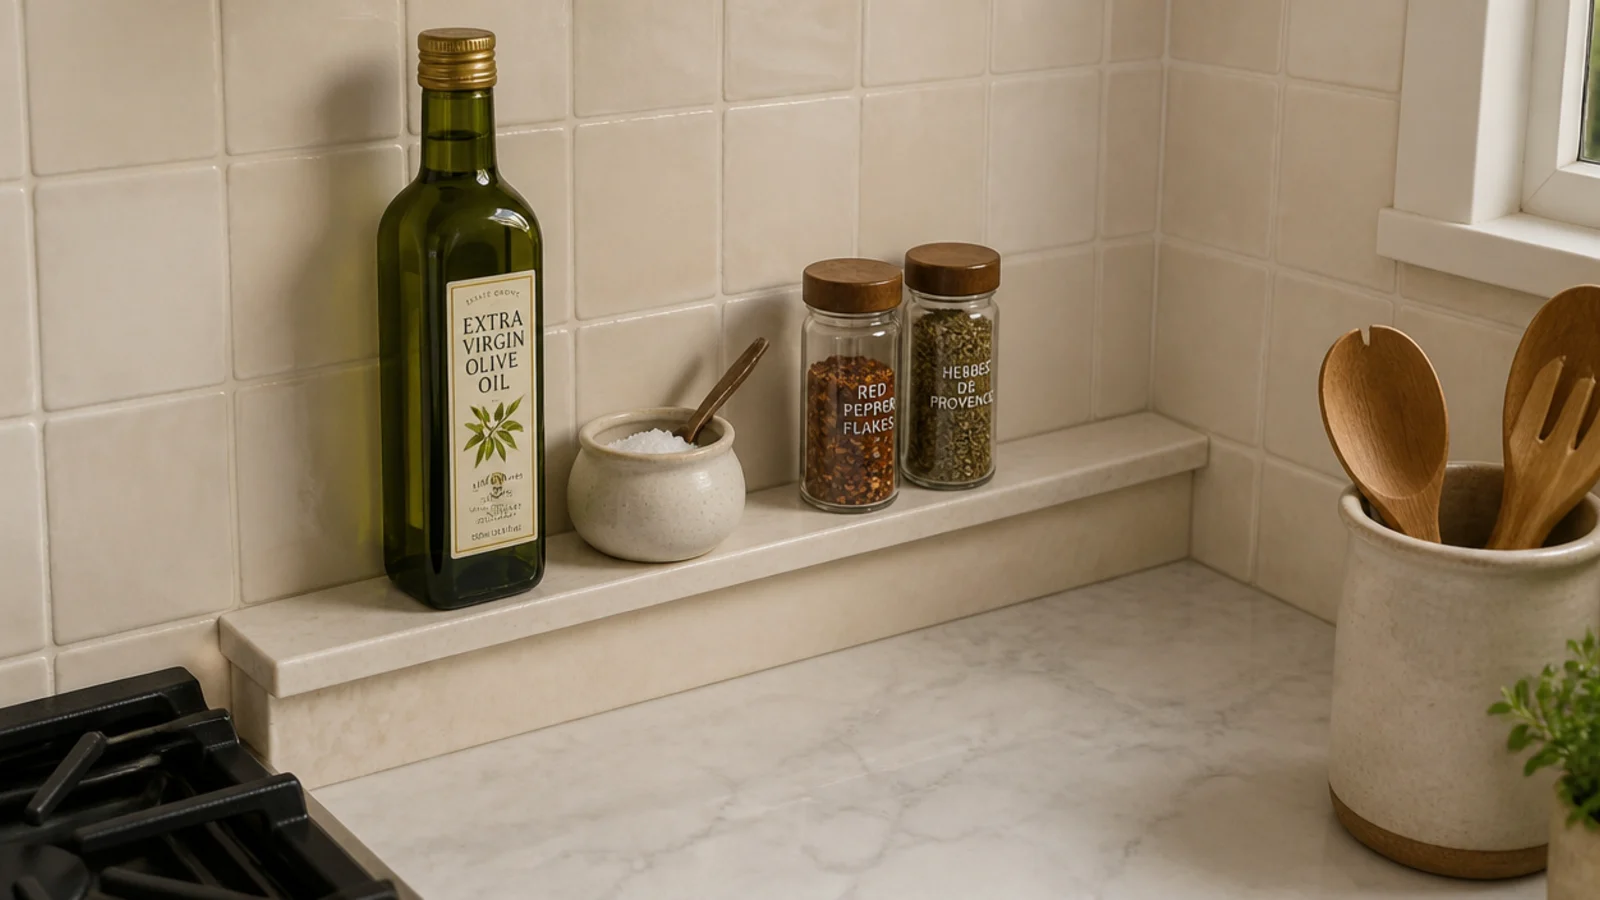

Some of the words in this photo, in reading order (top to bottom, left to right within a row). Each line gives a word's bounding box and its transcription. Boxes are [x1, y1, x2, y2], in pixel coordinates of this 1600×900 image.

[463, 310, 523, 335] EXTRA
[463, 330, 524, 355] VIRGIN
[465, 352, 518, 376] OLIVE
[479, 374, 510, 394] OIL
[858, 382, 886, 400] RED
[930, 389, 994, 410] PROVENCE
[843, 416, 894, 435] FLAKES
